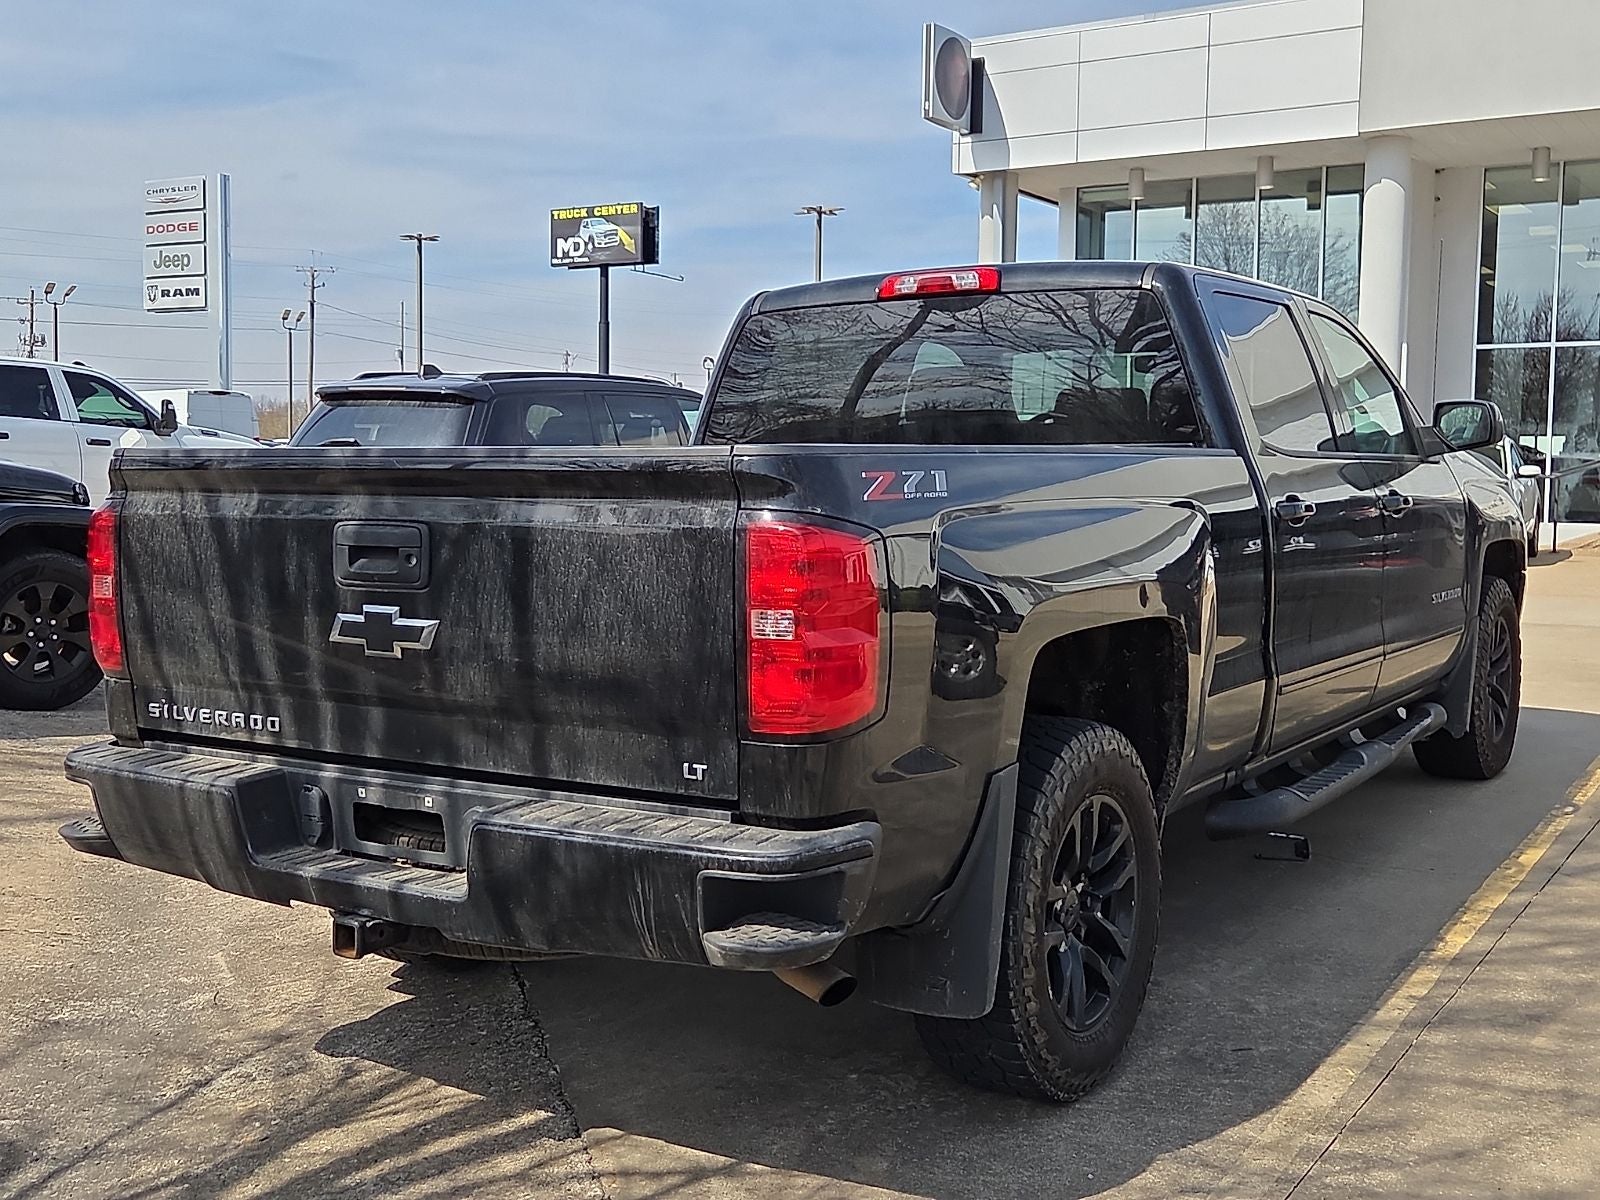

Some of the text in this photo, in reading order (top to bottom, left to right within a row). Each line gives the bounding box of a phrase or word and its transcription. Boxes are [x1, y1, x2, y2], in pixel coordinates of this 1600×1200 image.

[146, 185, 198, 196] CHRYSLER
[552, 204, 638, 220] TRUCK CENTER
[146, 221, 199, 235] DODGE
[556, 236, 585, 258] MD
[153, 250, 191, 271] Jeep
[160, 287, 201, 298] RAM
[861, 470, 947, 501] Z71
[148, 701, 280, 732] SILVERADO
[683, 762, 708, 780] LT
